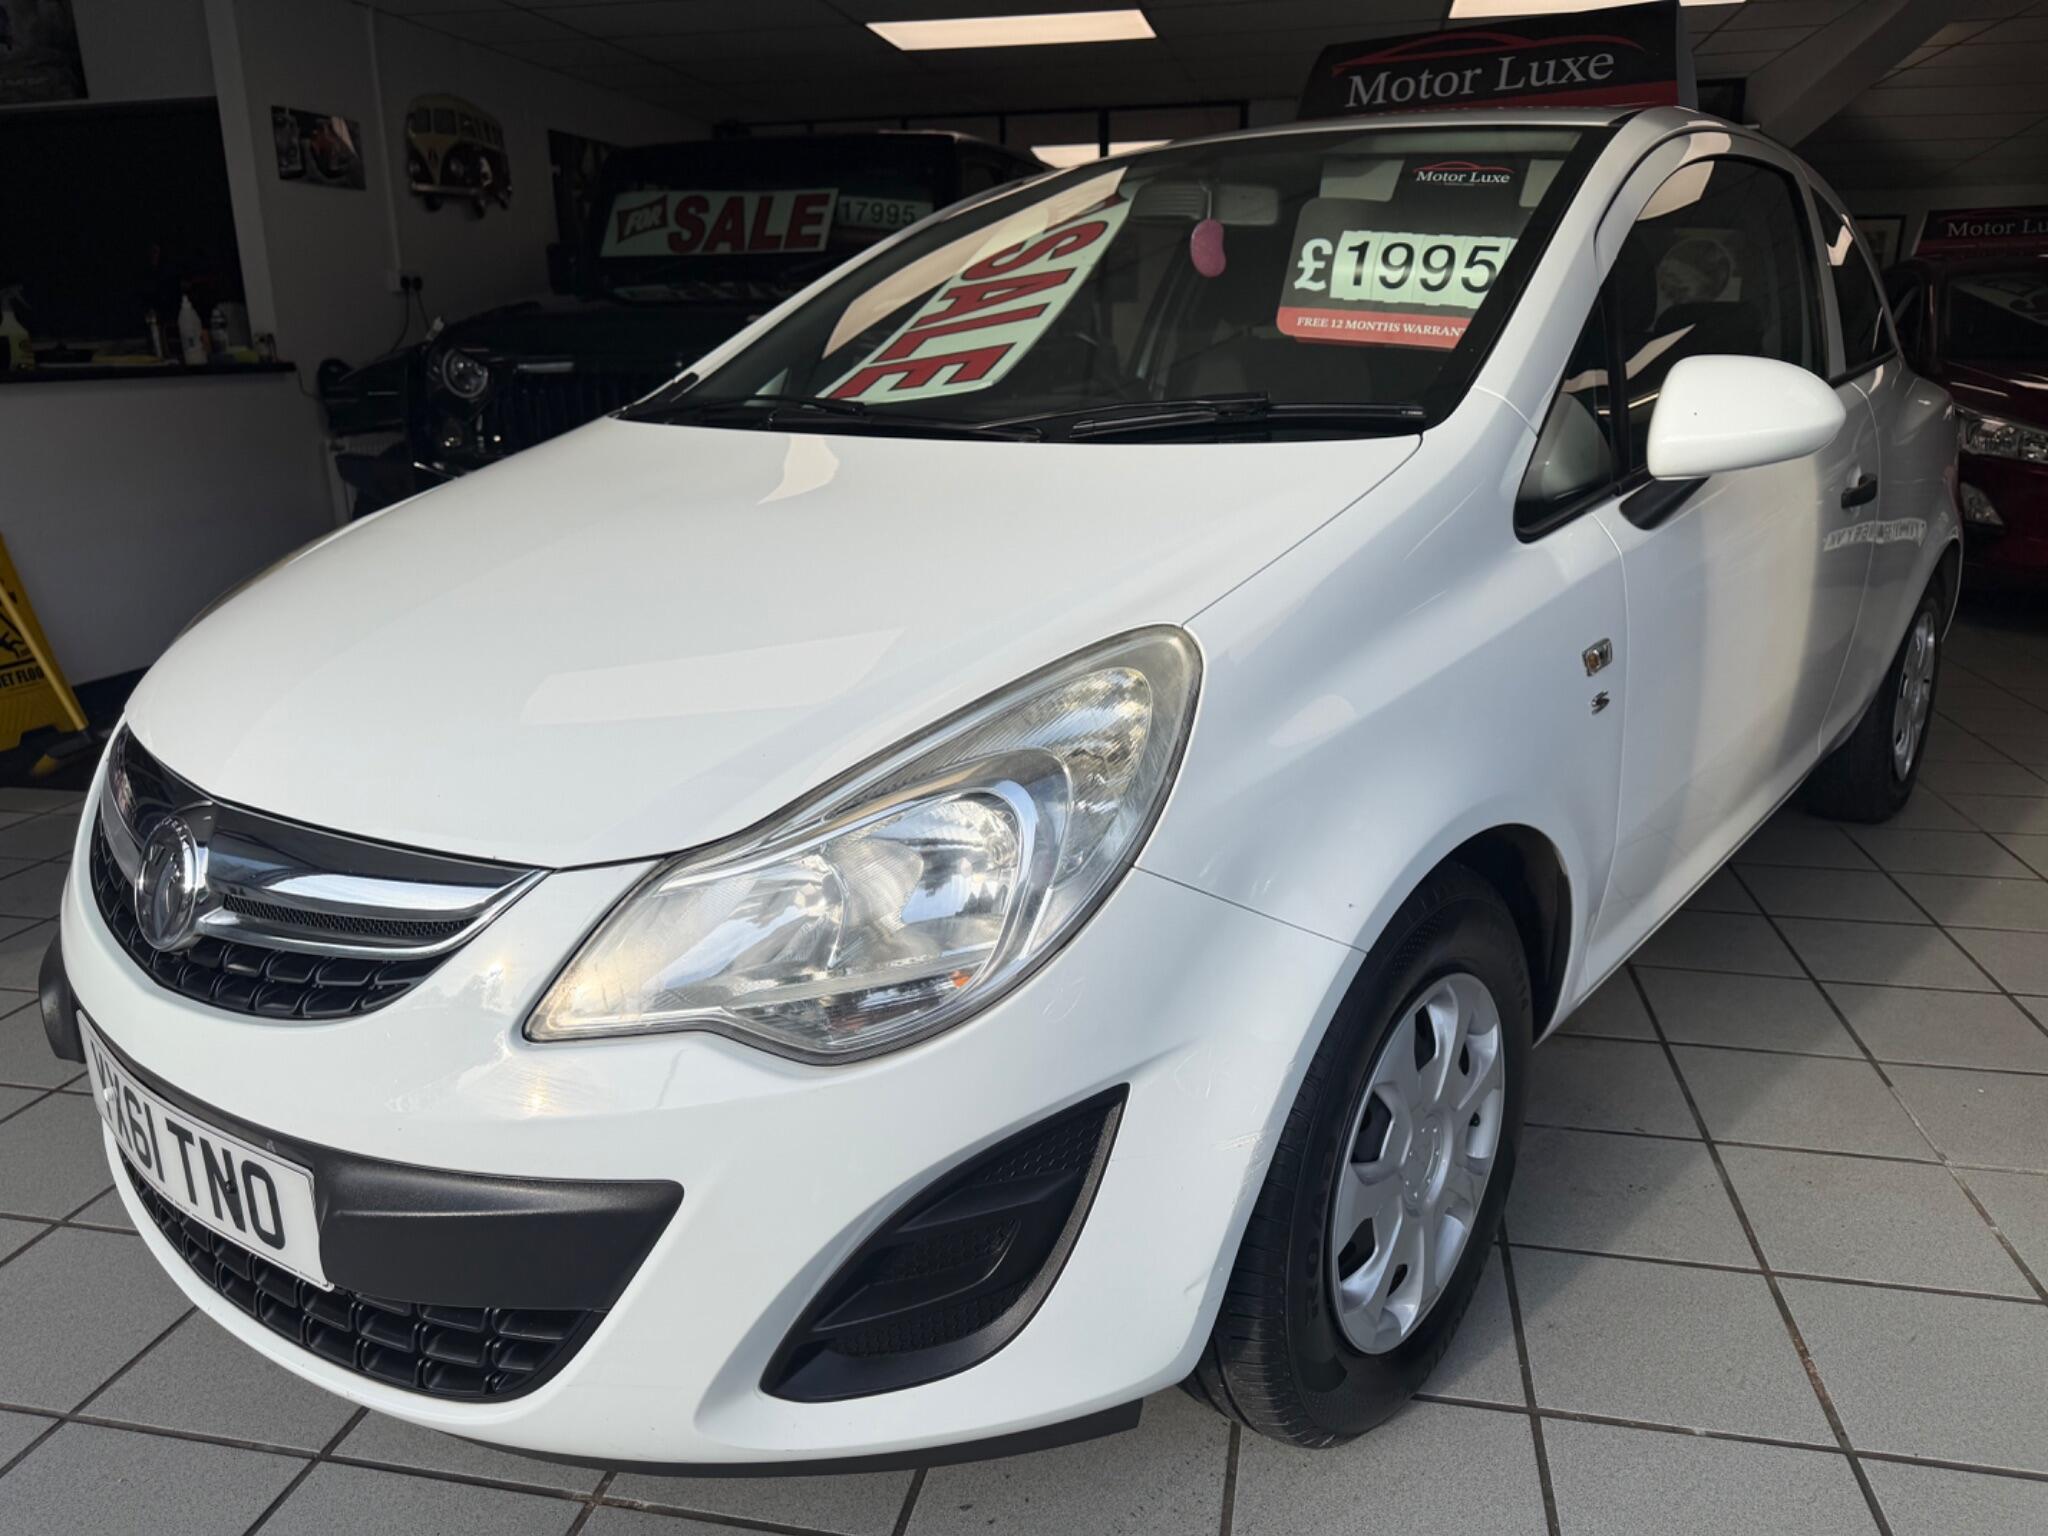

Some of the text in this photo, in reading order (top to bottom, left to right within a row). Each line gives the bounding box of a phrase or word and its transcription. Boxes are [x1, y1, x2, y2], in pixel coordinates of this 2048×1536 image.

[1344, 50, 1616, 109] Motor Luxe
[1416, 170, 1511, 184] Motor Luxe
[627, 193, 829, 254] FOR SALE
[841, 200, 917, 224] 17995
[1946, 221, 2017, 238] Motor
[827, 220, 1109, 402] SALE
[1296, 316, 1330, 328] FREE
[1330, 318, 1343, 329] 12
[1344, 319, 1401, 333] MONTHS
[0, 671, 15, 689] ET
[164, 1116, 287, 1252] TNO
